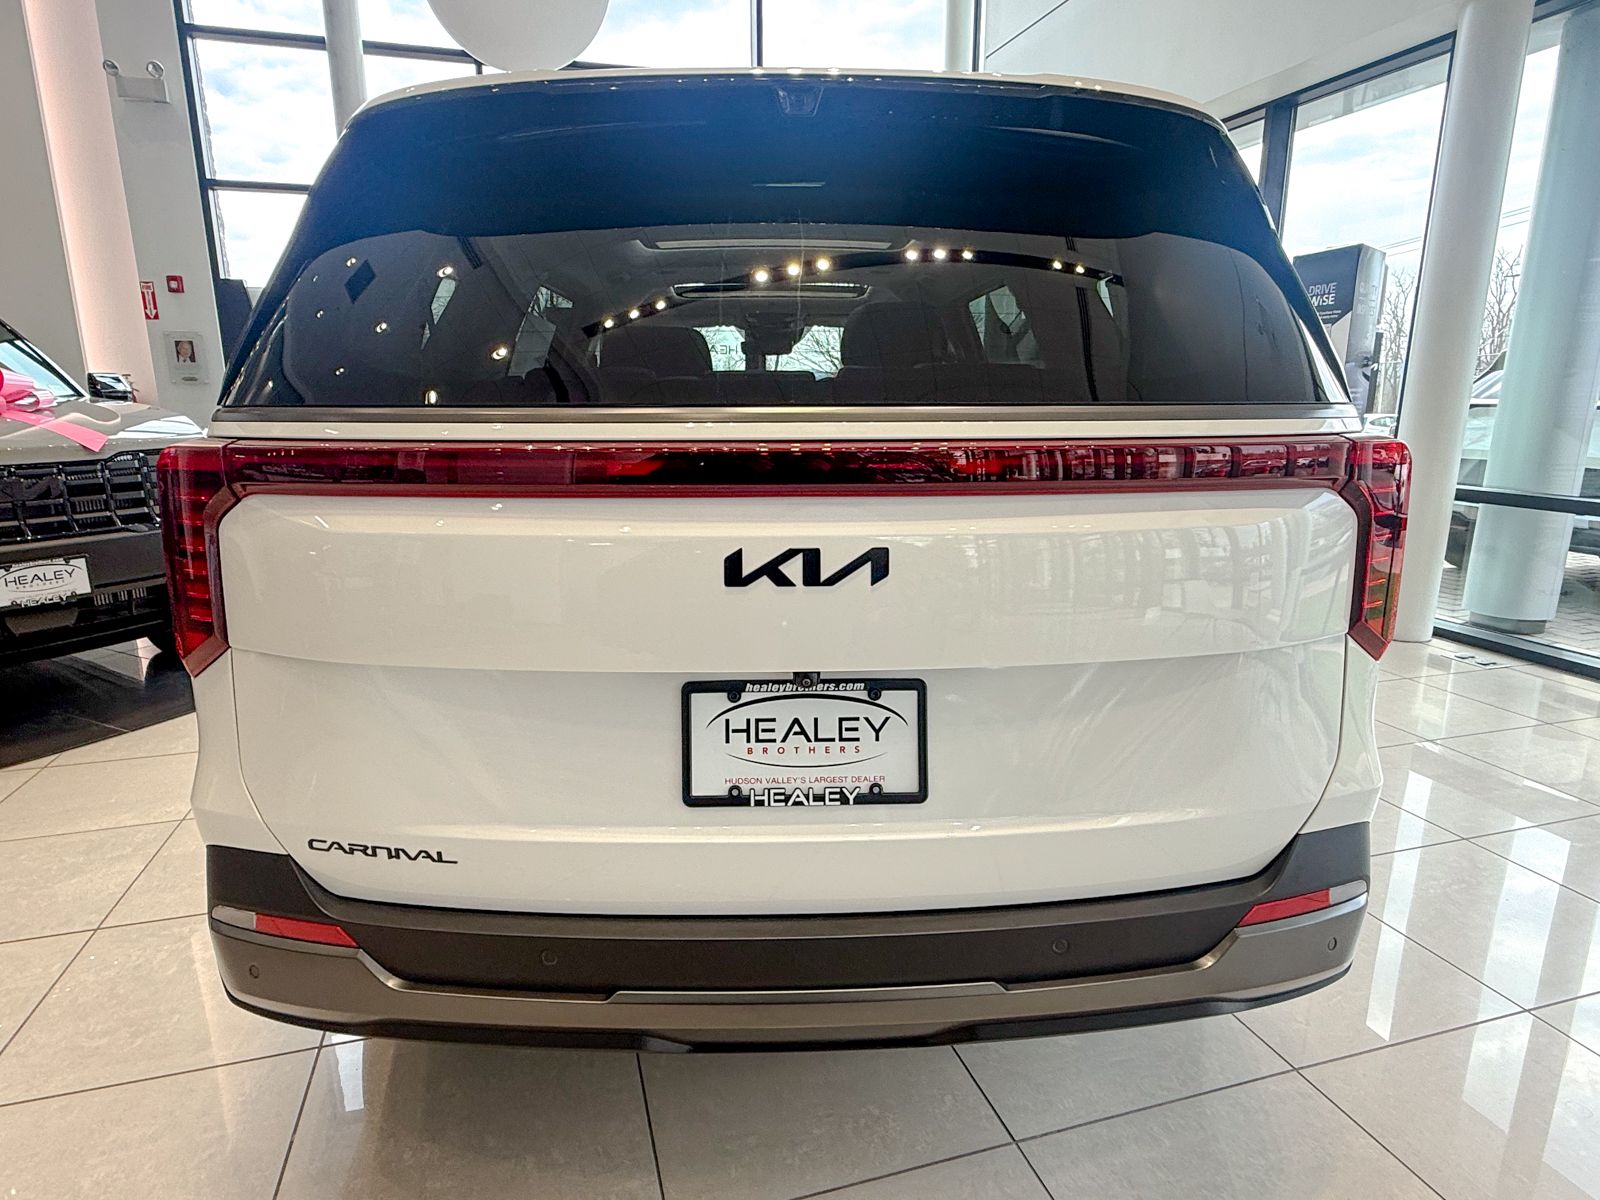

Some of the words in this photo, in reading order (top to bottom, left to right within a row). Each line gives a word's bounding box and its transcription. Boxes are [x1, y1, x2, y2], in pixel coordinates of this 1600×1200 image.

[1309, 282, 1337, 295] DRIVE
[724, 547, 890, 587] KIA
[4, 568, 75, 587] HEALEY
[724, 716, 891, 744] HEALEY
[746, 745, 861, 755] BROTHERS
[724, 777, 763, 785] HUDSON
[765, 776, 807, 785] VALLEY'S
[808, 775, 849, 784] LARGEST
[851, 775, 886, 783] DEALER
[750, 786, 861, 807] HEALEY
[307, 838, 459, 864] CARNIVAL
